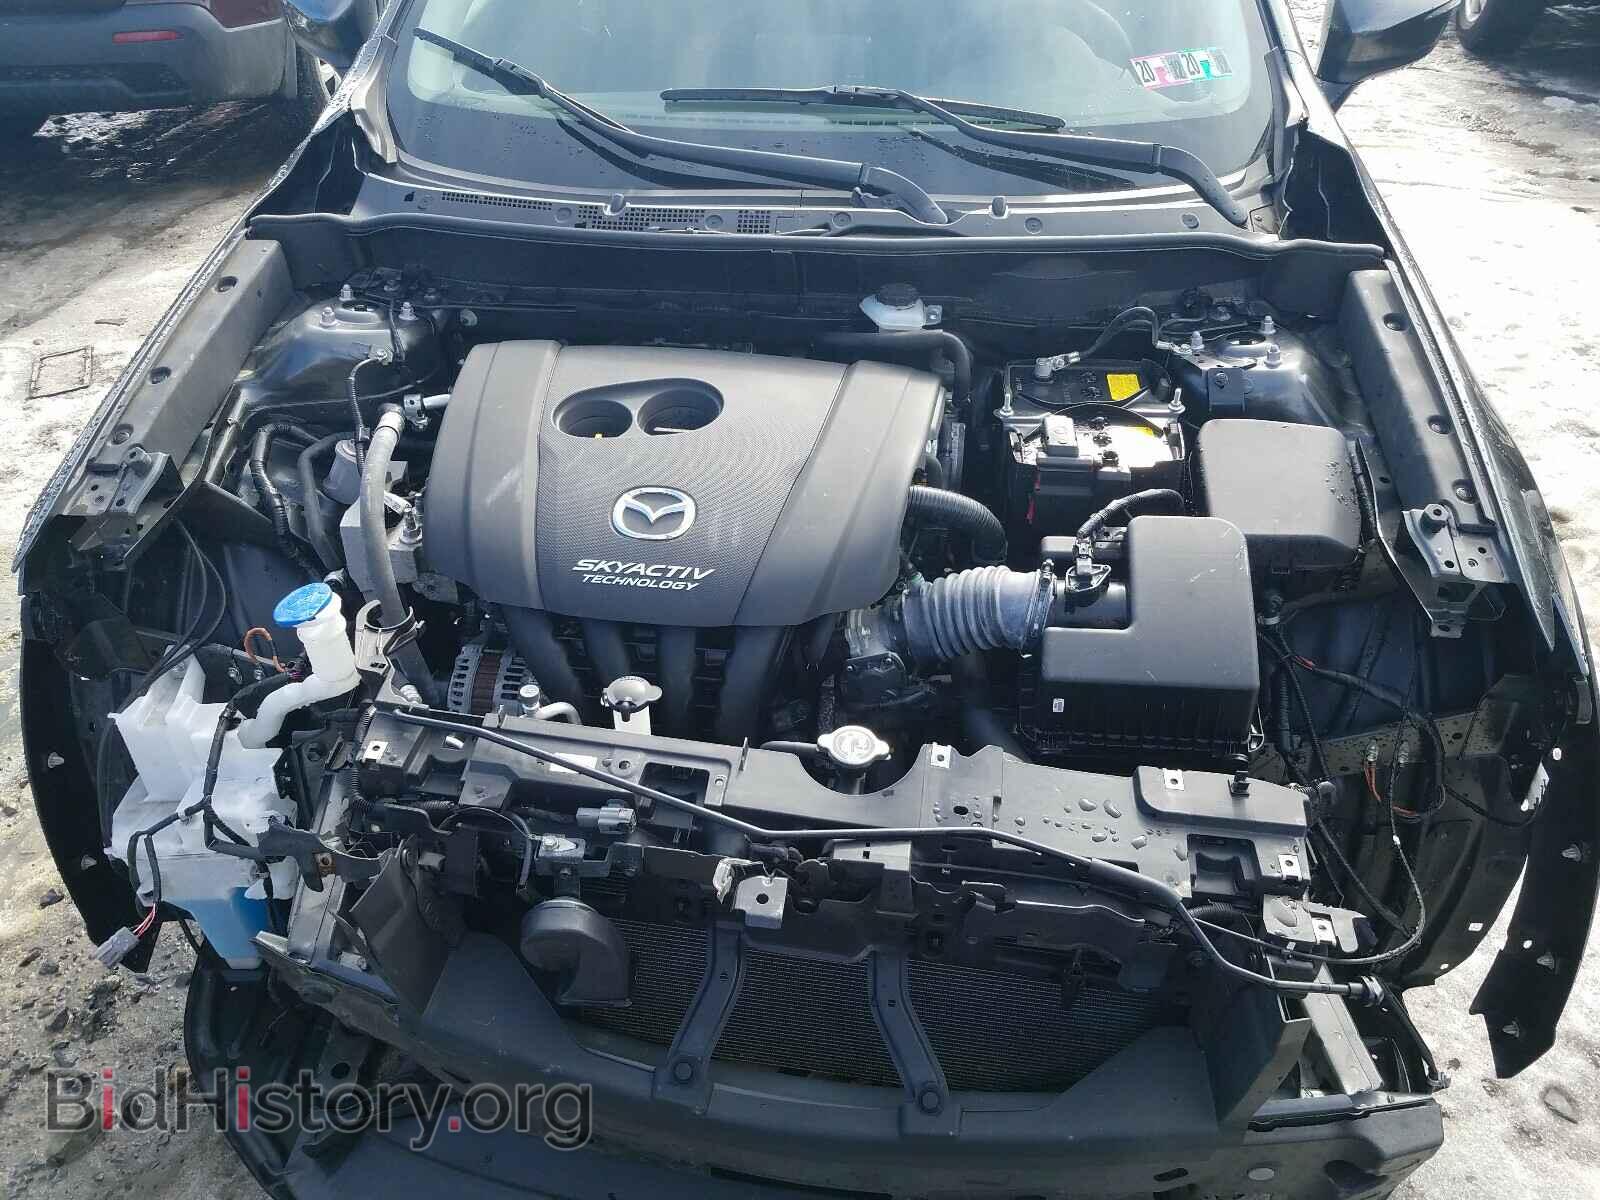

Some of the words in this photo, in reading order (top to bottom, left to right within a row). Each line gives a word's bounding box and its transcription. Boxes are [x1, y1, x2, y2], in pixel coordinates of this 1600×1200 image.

[1135, 60, 1156, 83] 20
[1181, 53, 1201, 75] 20
[572, 559, 716, 580] SKYACTIV
[582, 574, 701, 590] TECHNOLOGY
